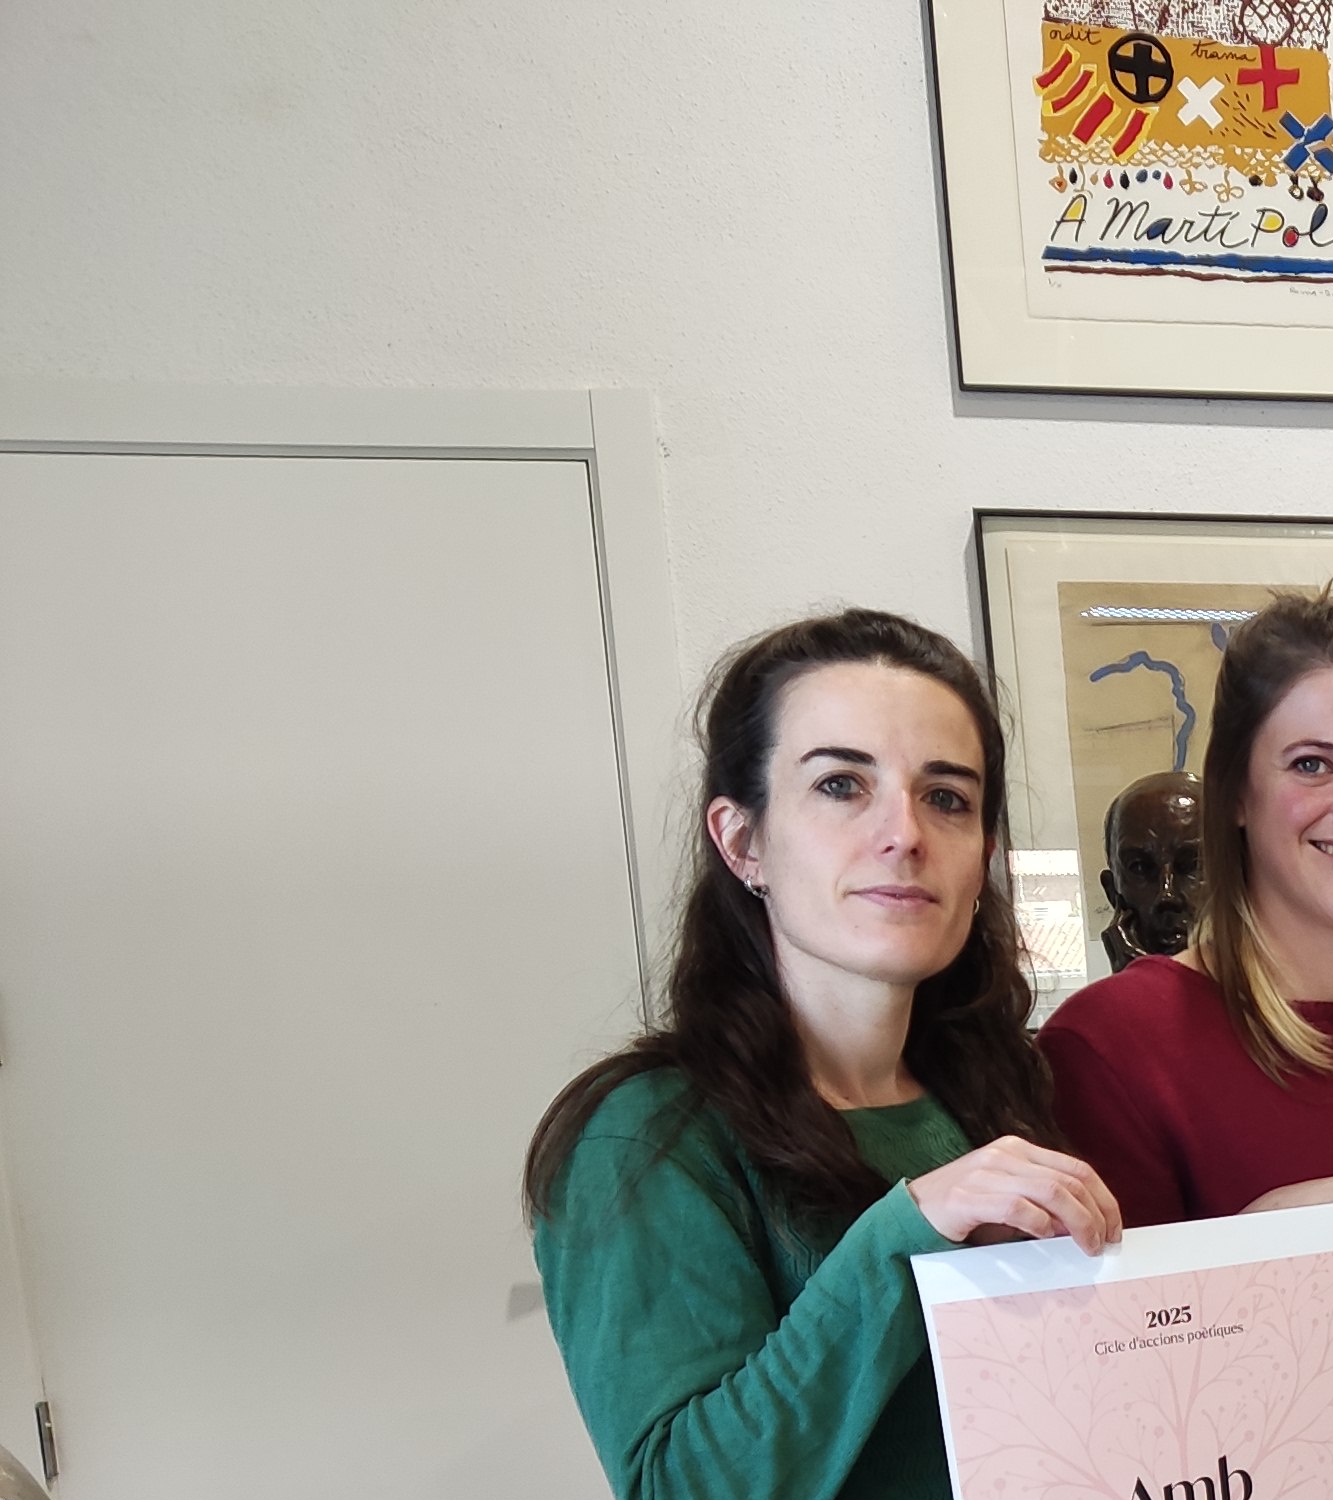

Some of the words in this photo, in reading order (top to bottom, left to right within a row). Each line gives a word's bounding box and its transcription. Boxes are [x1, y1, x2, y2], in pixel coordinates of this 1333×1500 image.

[1051, 28, 1101, 45] ordit
[1191, 40, 1256, 62] trama
[1051, 193, 1087, 242] A
[1099, 197, 1249, 248] Martí
[1145, 1305, 1192, 1331] 2025
[1094, 1338, 1130, 1357] Cicle
[1130, 1331, 1185, 1351] d'accions
[1186, 1320, 1244, 1343] poètiques
